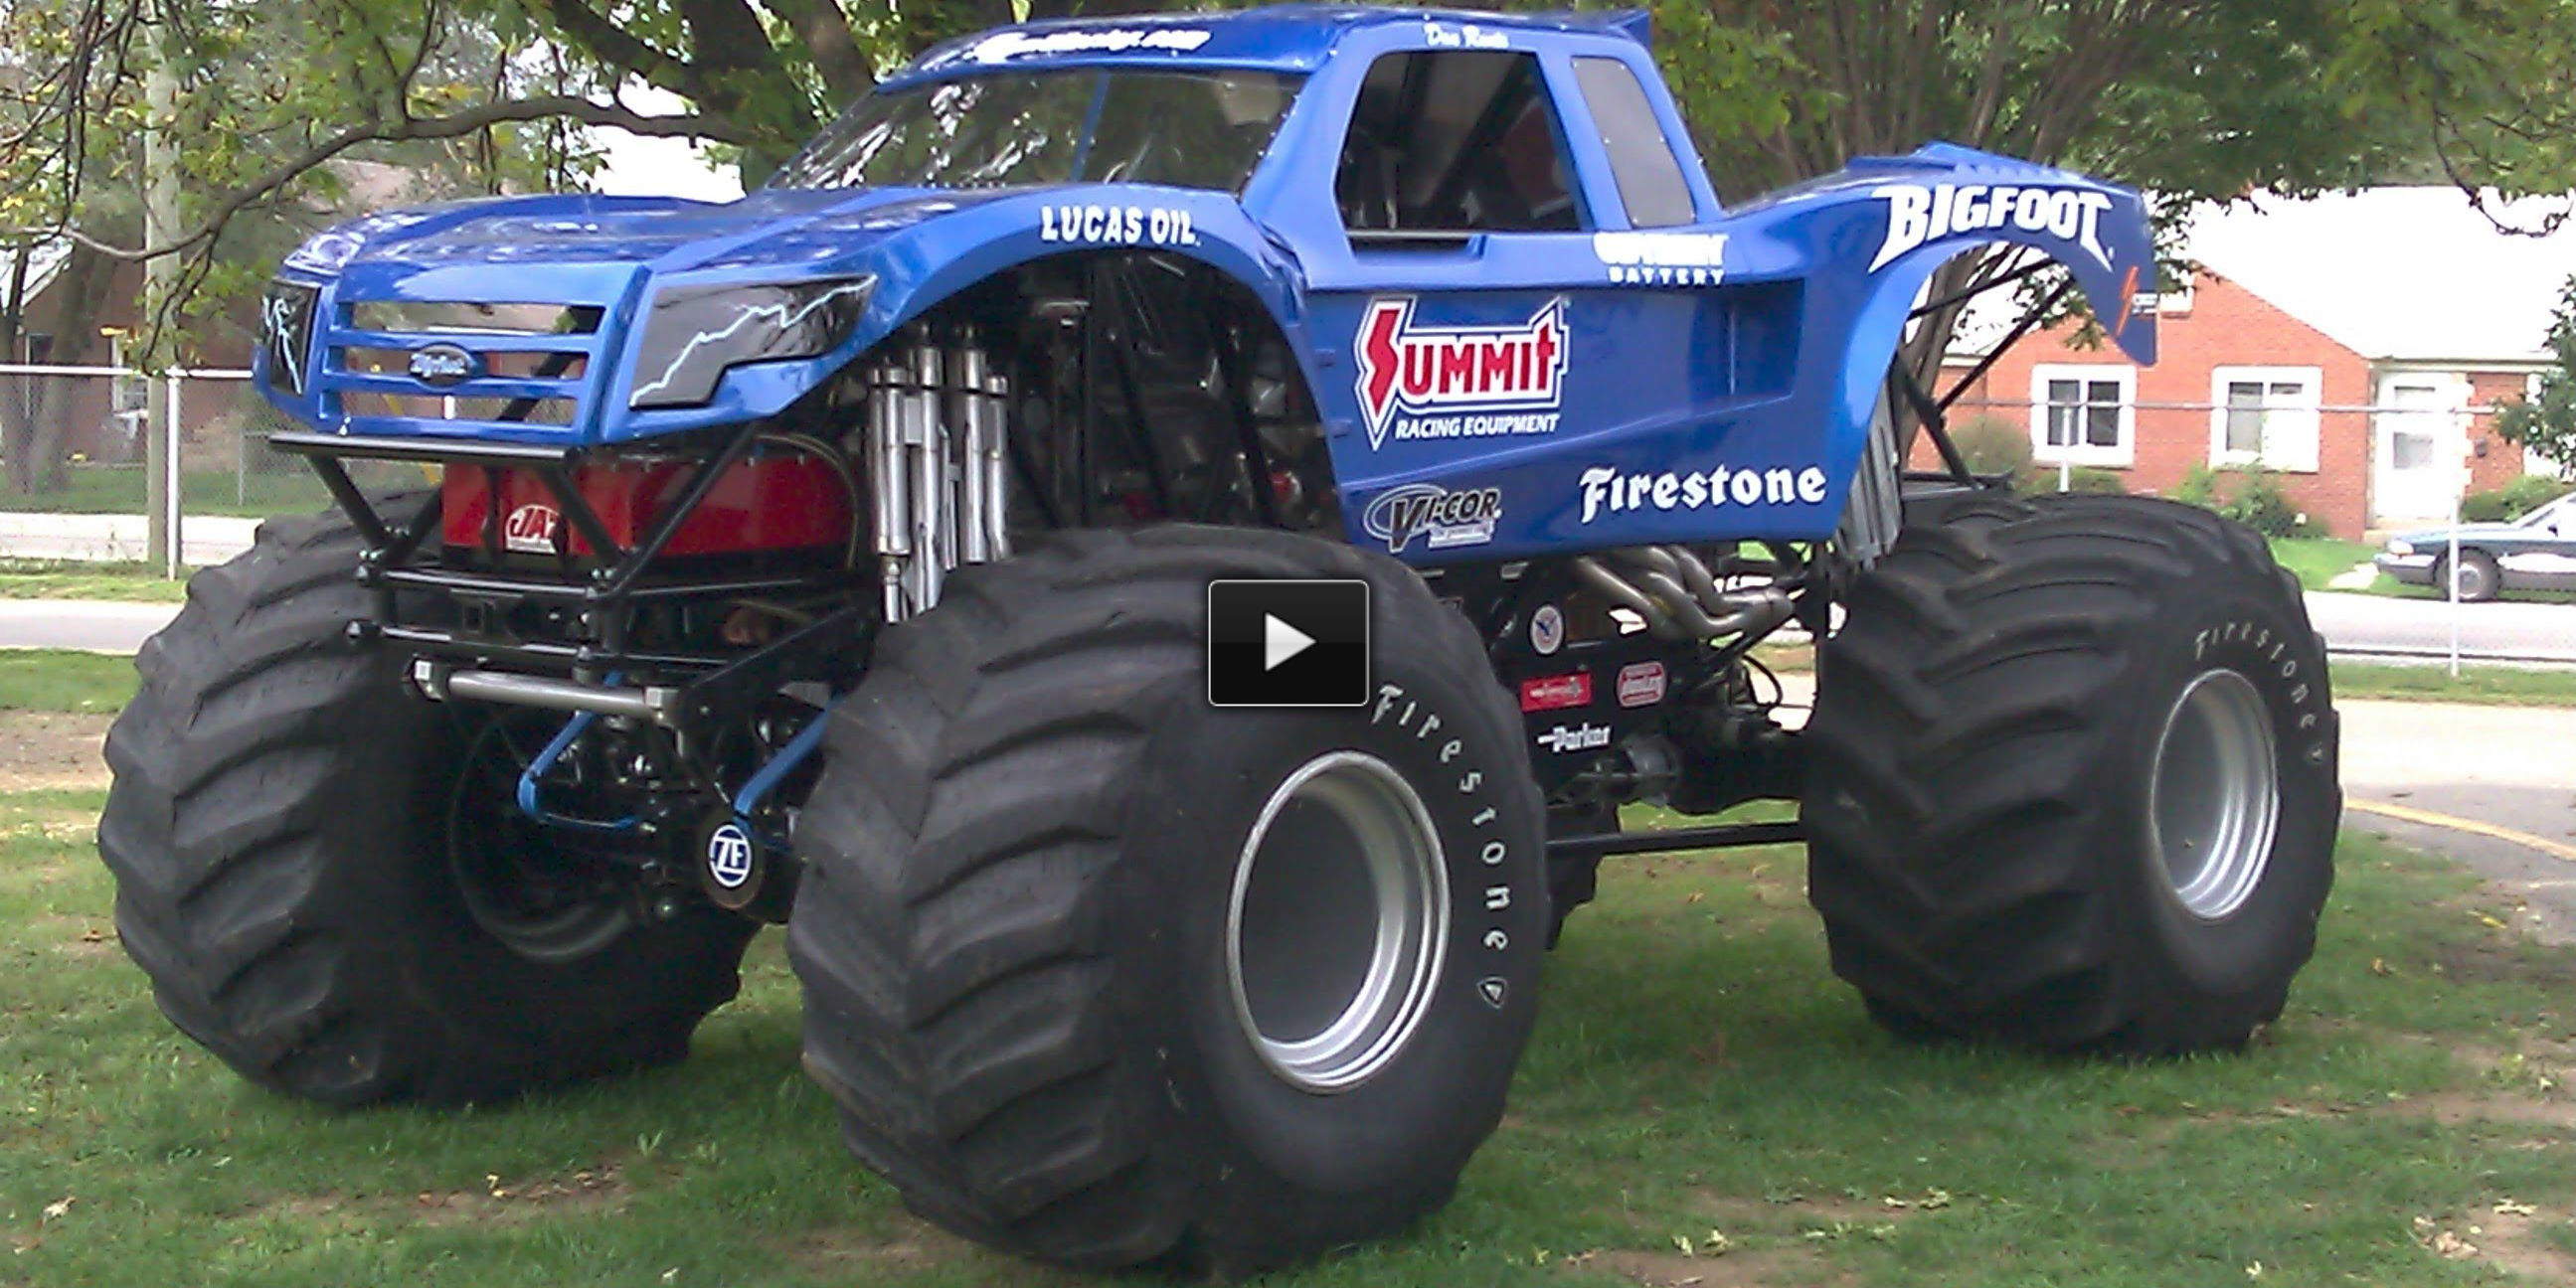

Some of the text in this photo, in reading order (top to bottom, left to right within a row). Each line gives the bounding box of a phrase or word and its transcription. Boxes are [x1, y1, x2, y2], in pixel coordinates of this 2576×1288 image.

[1041, 205, 1197, 245] LUCAS OIL
[1868, 183, 2114, 273] BIGFOOT
[1608, 265, 1725, 285] BATTERY
[1395, 413, 1560, 440] RACING EQUIPMENT
[1579, 464, 1826, 524] Firestone
[1551, 722, 1611, 753] Parker
[1371, 684, 1511, 952] Firestone
